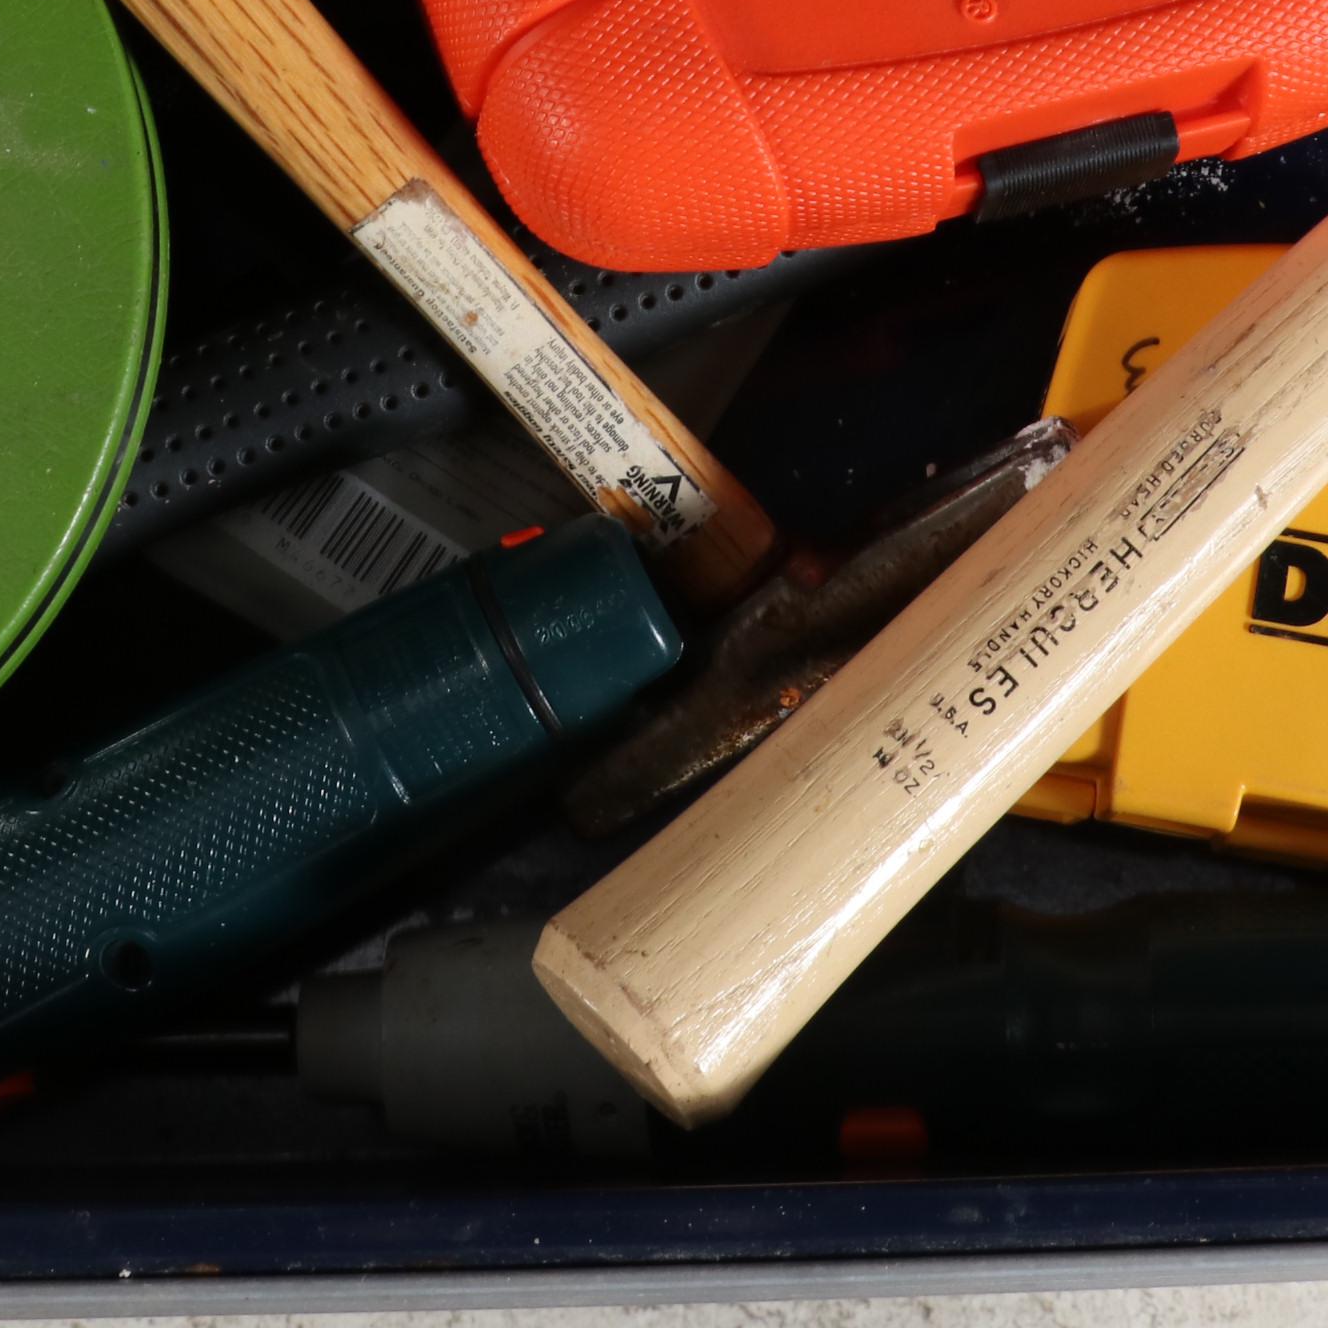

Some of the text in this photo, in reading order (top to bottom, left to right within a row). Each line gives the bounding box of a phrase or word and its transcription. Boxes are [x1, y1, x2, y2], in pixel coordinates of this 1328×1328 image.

[542, 334, 569, 363] injury.
[562, 357, 589, 385] bodily
[502, 370, 529, 399] another
[543, 378, 559, 394] not
[567, 384, 585, 403] tool
[582, 380, 605, 403] other
[524, 395, 553, 425] against
[540, 394, 562, 417] other
[554, 389, 587, 424] resulting
[608, 407, 625, 425] eye
[547, 422, 570, 447] struck
[565, 423, 582, 441] face
[598, 420, 631, 454] damage
[572, 448, 591, 468] chip
[578, 438, 595, 456] tool
[624, 462, 687, 530] WARNING
[1028, 537, 1098, 610] HICKORY
[968, 536, 1143, 717] HERCULES
